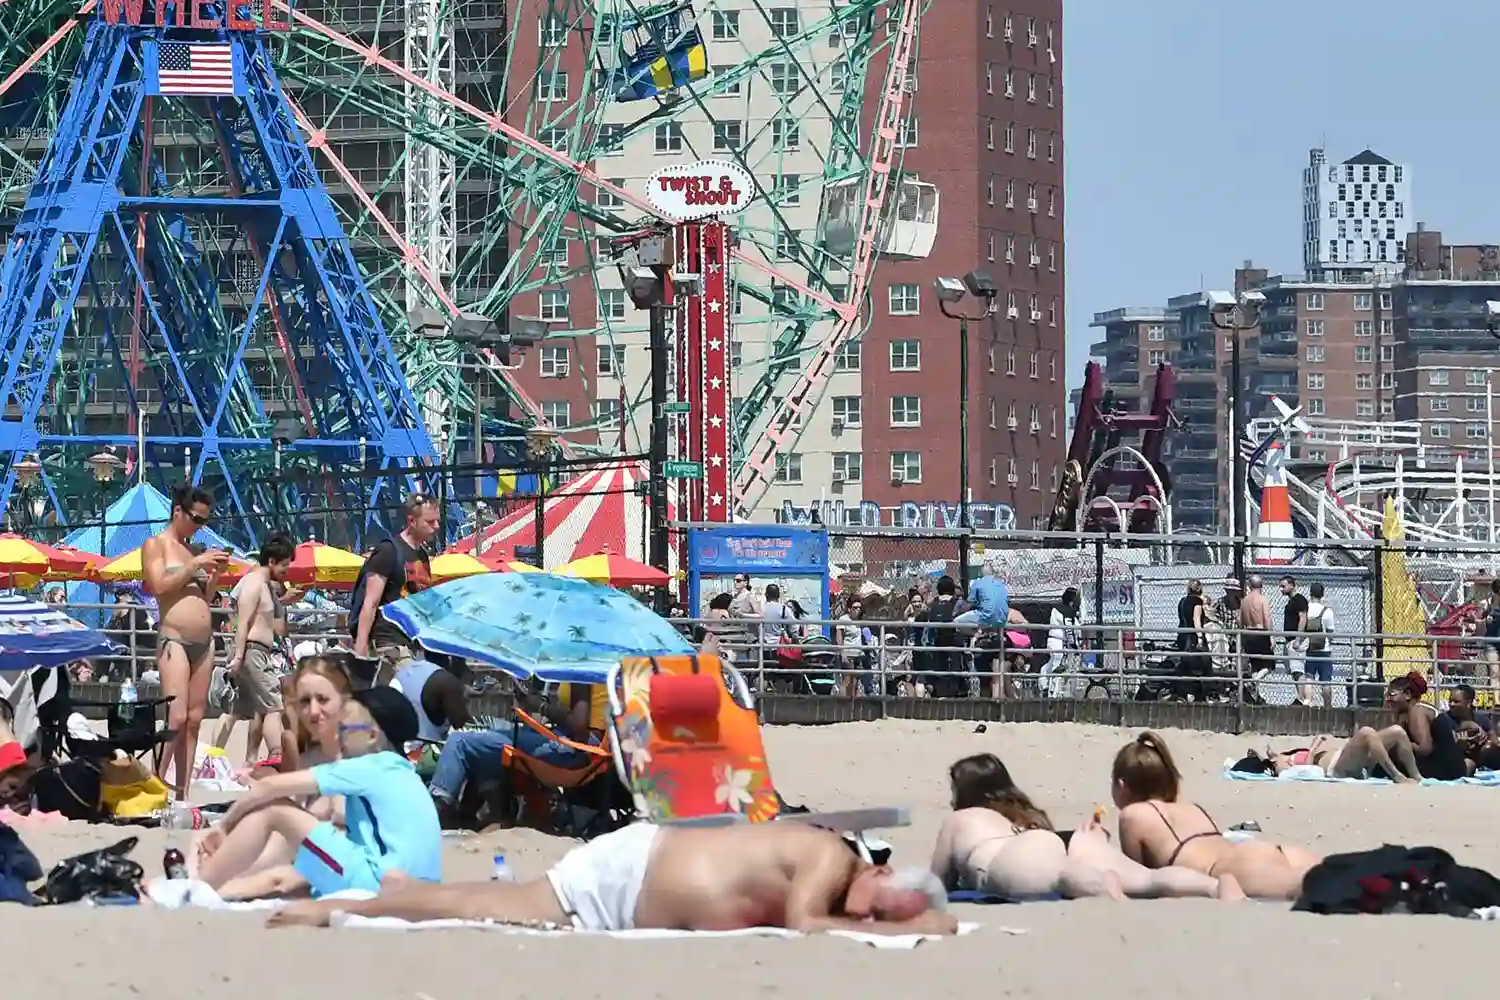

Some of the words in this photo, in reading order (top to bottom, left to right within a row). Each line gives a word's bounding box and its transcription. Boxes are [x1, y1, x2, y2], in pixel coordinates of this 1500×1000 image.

[657, 175, 713, 192] TWIST
[719, 175, 733, 191] &
[685, 189, 742, 206] SHOUT
[781, 500, 880, 529] WILD
[901, 501, 1016, 531] RIVER
